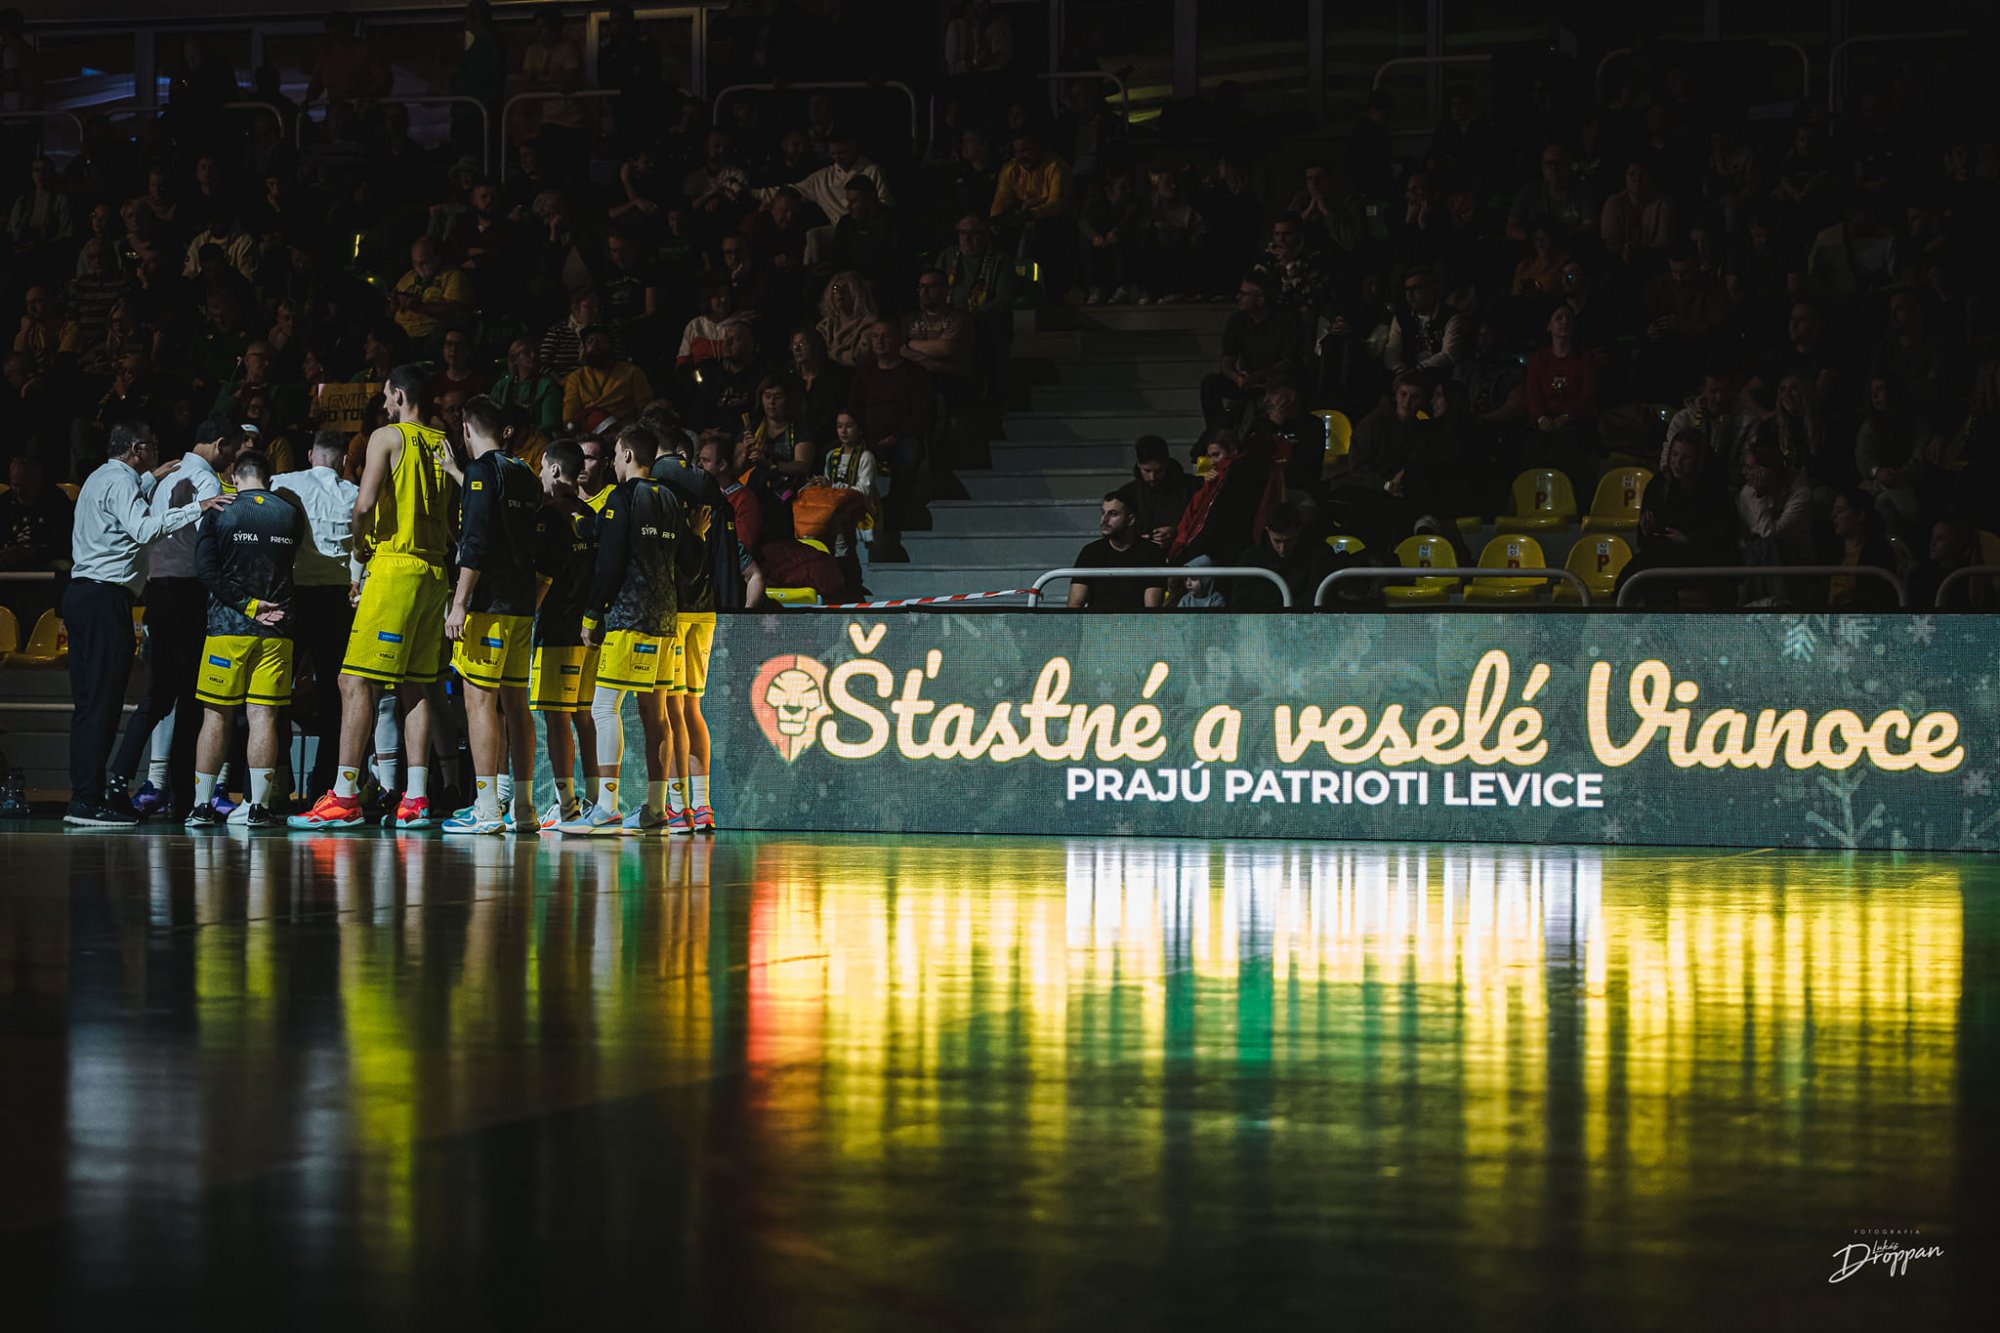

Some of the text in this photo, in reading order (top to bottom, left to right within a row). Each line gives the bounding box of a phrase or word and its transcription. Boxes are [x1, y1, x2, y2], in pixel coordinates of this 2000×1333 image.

[233, 530, 259, 542] SÝPKA
[820, 623, 1965, 774] Šťastné a veselé Vianoce
[1066, 761, 1605, 809] PRAJÚ PATRIOTI LEVICE
